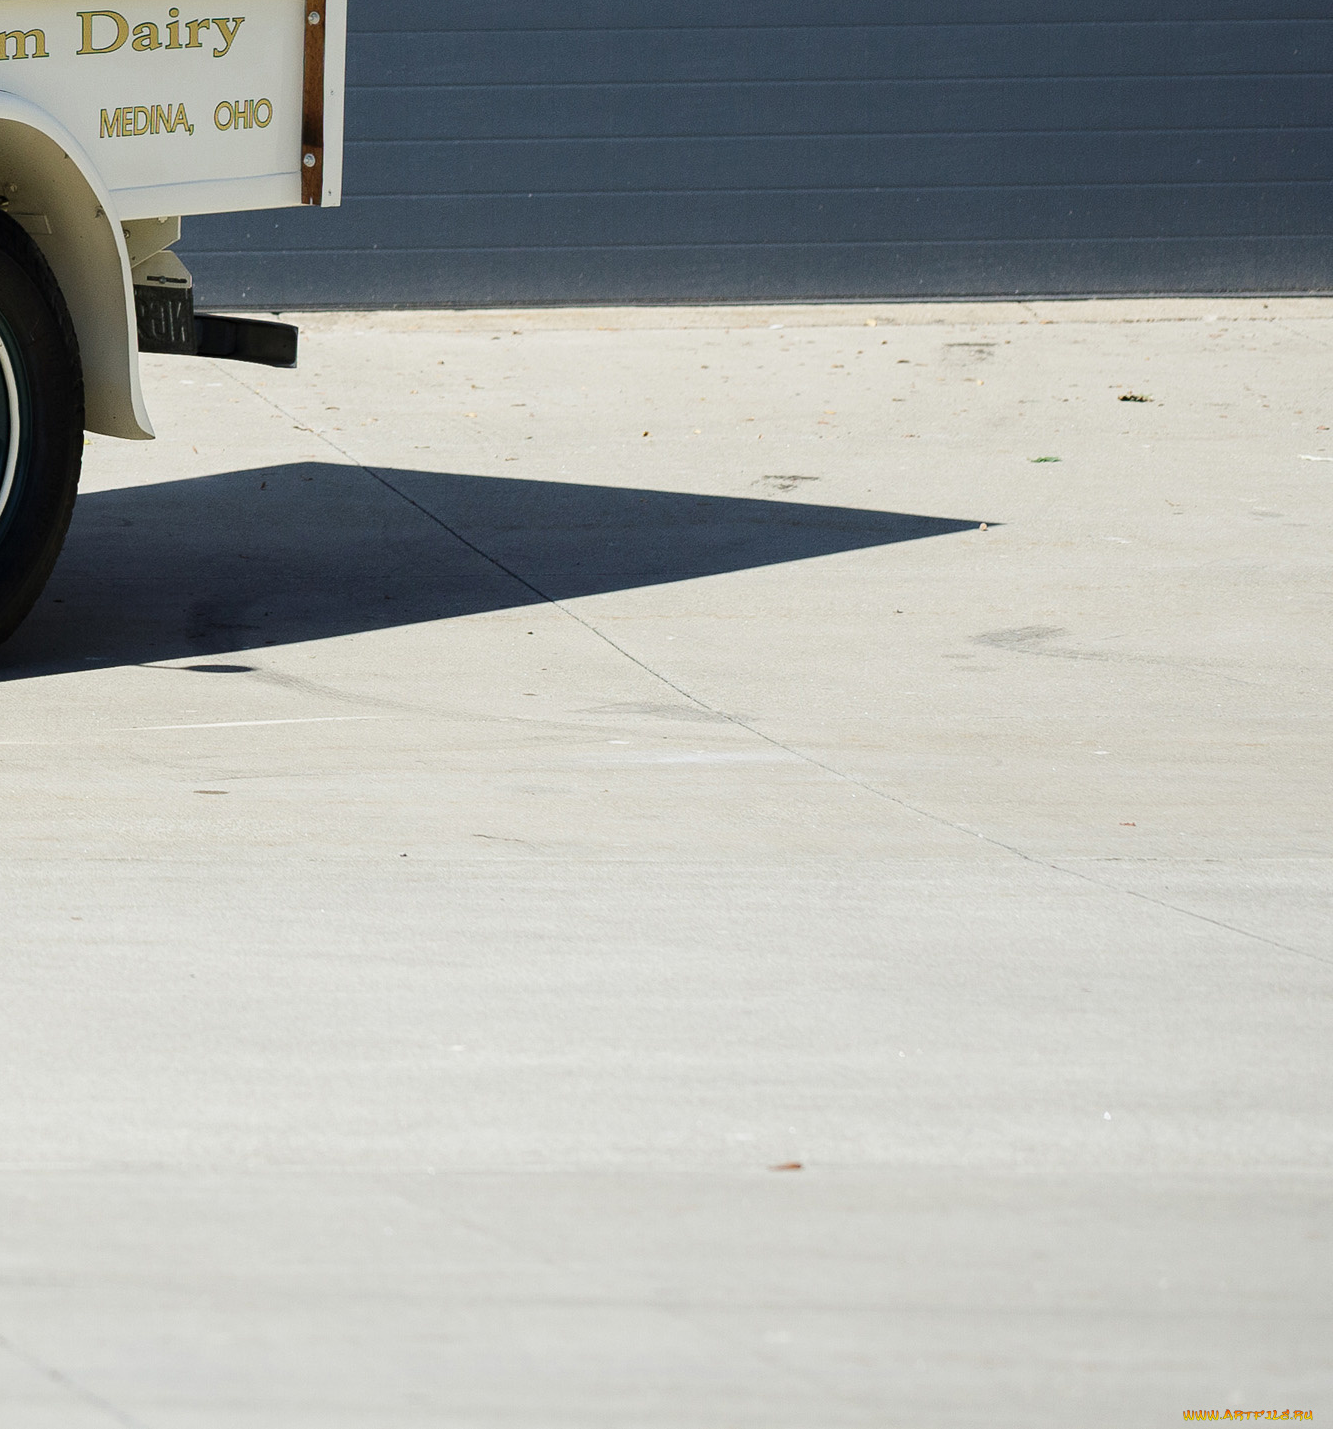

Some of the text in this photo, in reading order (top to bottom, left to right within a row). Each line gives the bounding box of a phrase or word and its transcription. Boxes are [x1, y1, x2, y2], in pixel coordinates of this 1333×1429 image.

[76, 7, 245, 58] Dairy
[99, 98, 273, 138] MEDINA, OHIO
